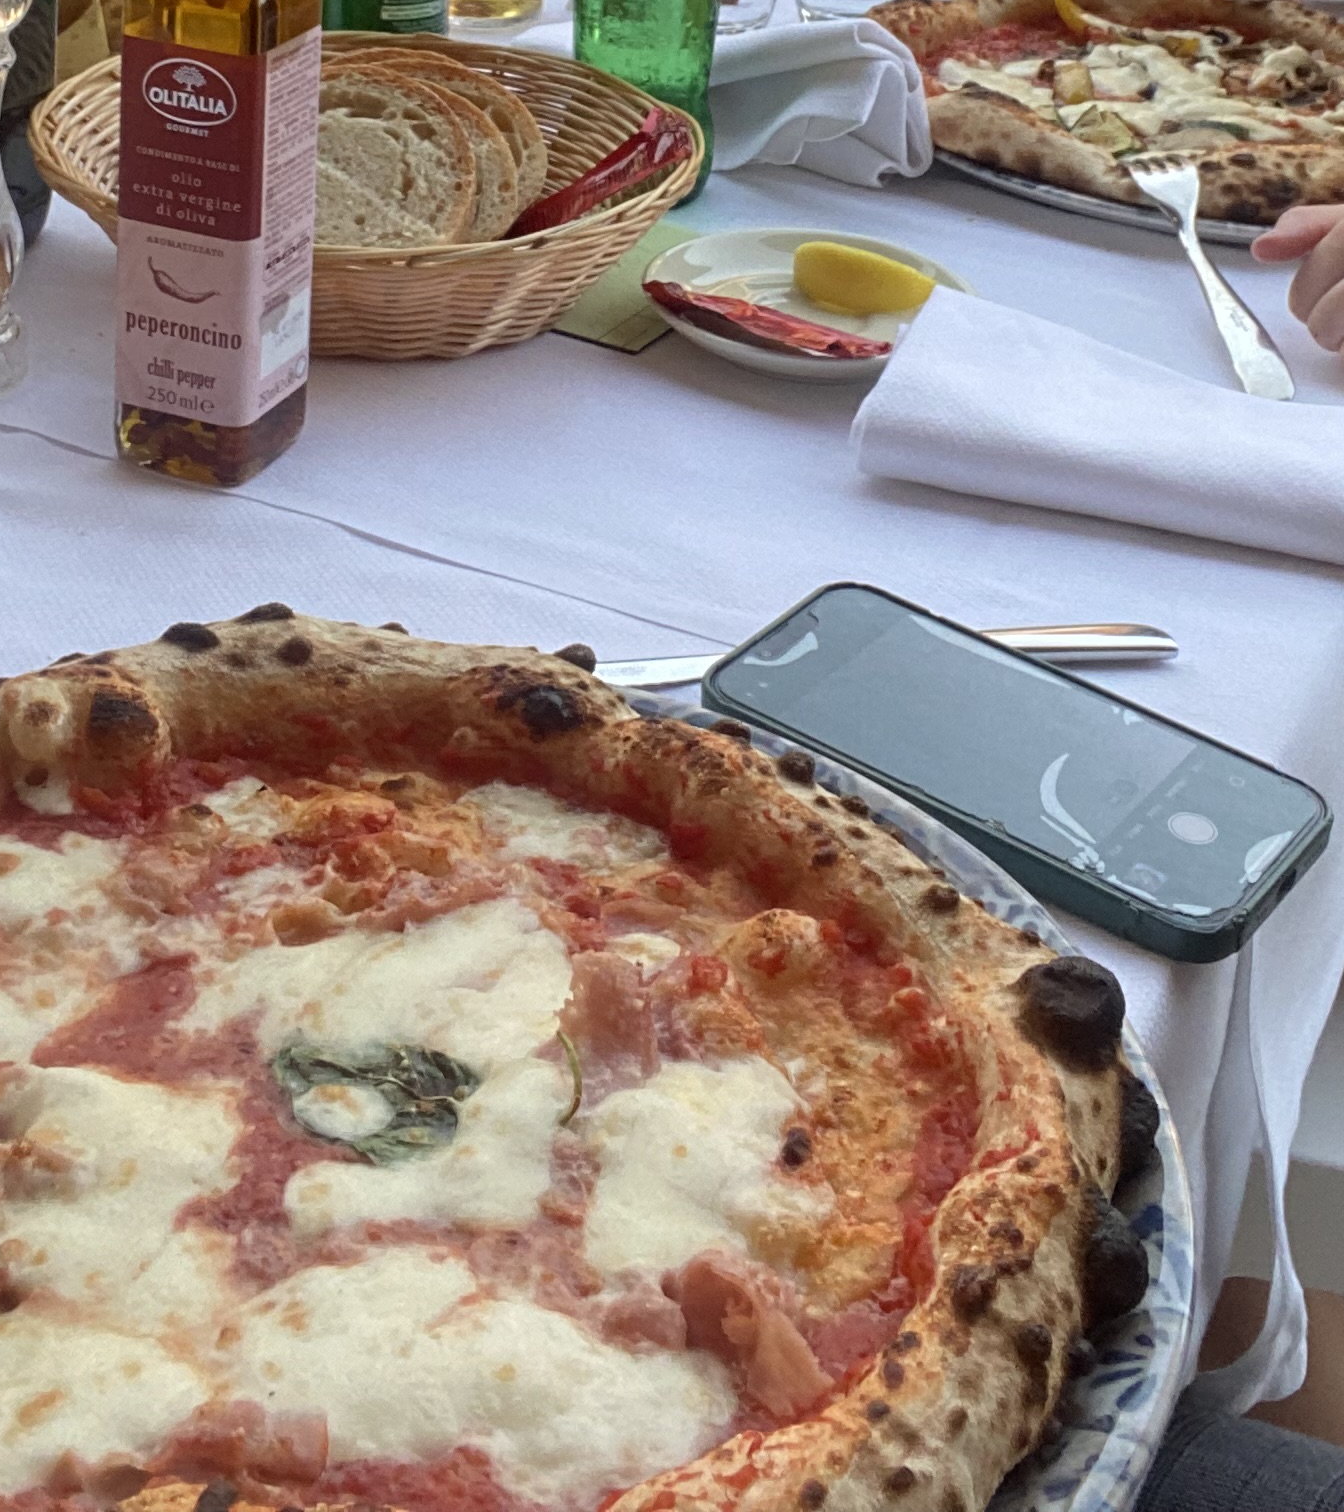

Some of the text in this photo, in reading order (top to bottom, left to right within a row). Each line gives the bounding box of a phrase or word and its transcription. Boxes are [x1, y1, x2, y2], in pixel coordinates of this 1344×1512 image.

[149, 87, 228, 116] OLITALIA
[166, 123, 209, 138] GOURMET
[136, 145, 197, 164] CONDIMENTO
[172, 172, 202, 188] olio
[133, 182, 242, 213] extra vergine
[156, 202, 216, 227] di oliva
[146, 235, 224, 258] AROMATIZZATO
[125, 310, 243, 350] peperoncino
[147, 356, 216, 390] chilli pepper
